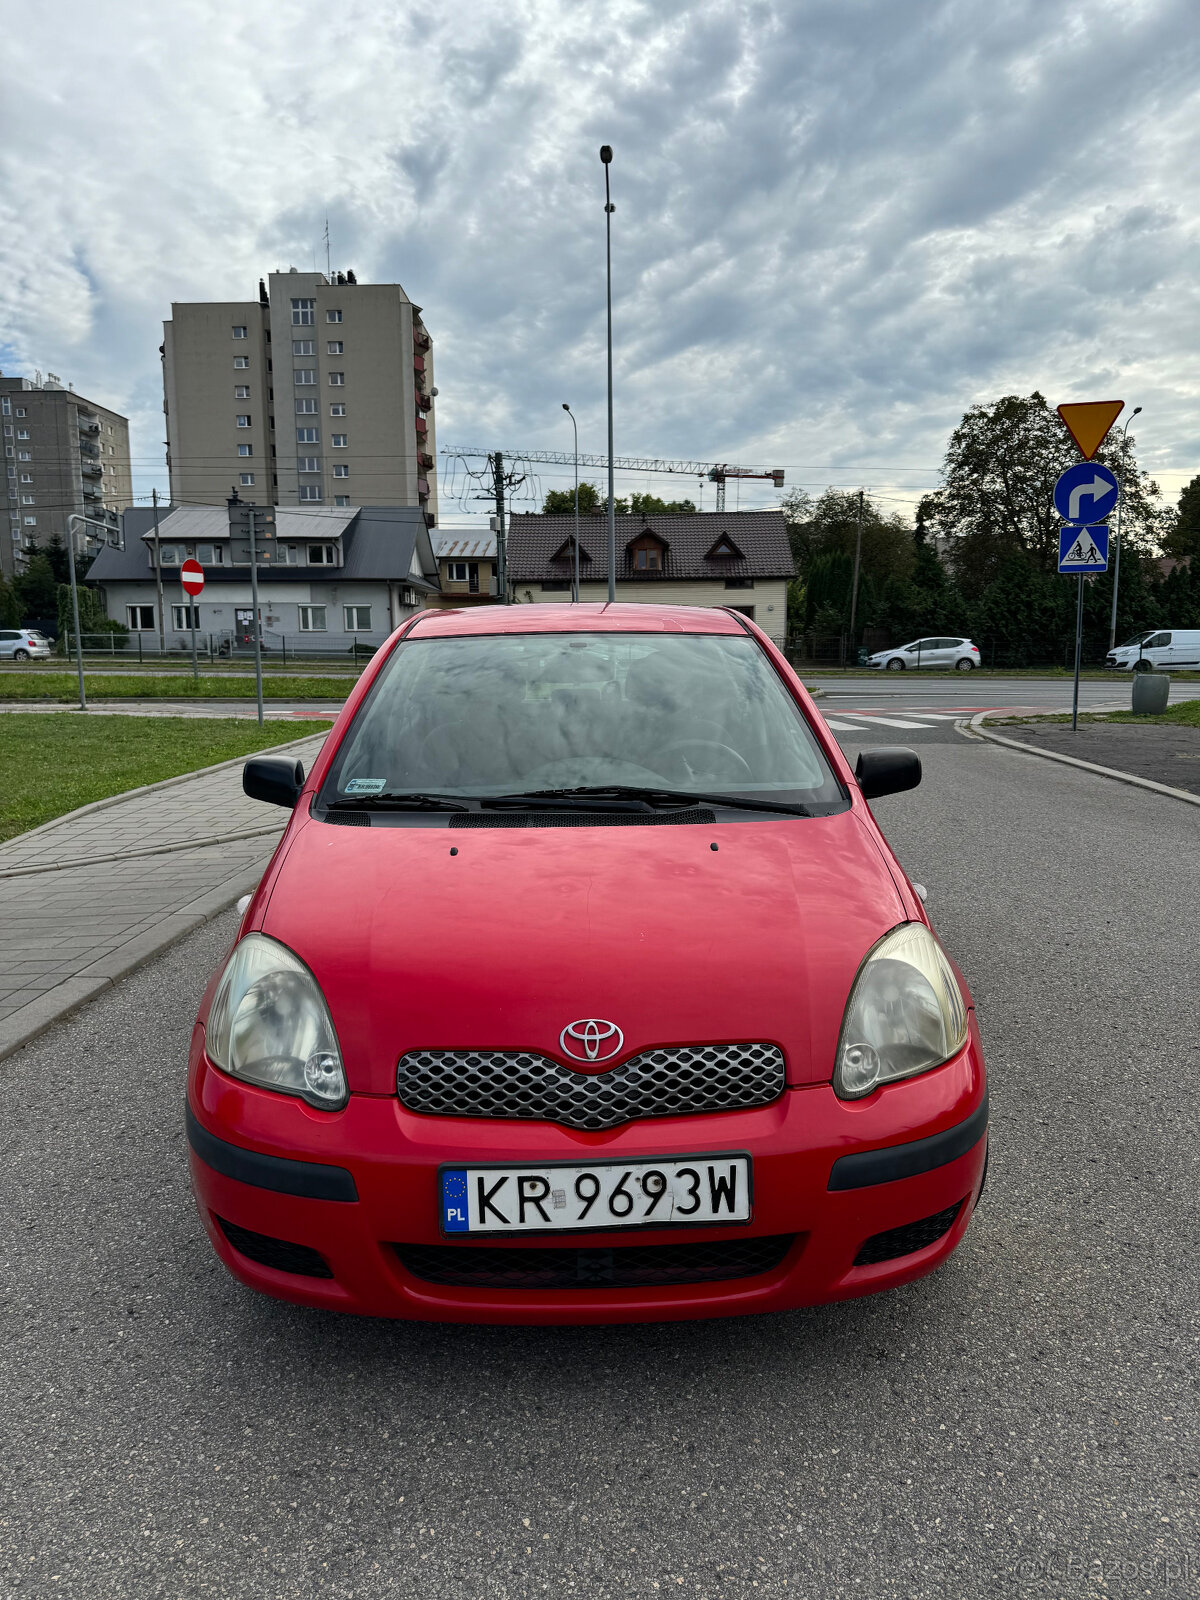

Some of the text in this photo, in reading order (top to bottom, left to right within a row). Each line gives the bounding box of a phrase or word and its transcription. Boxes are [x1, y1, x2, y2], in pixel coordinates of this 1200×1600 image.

[477, 1165, 737, 1224] KR 9693W
[447, 1208, 465, 1222] PL
